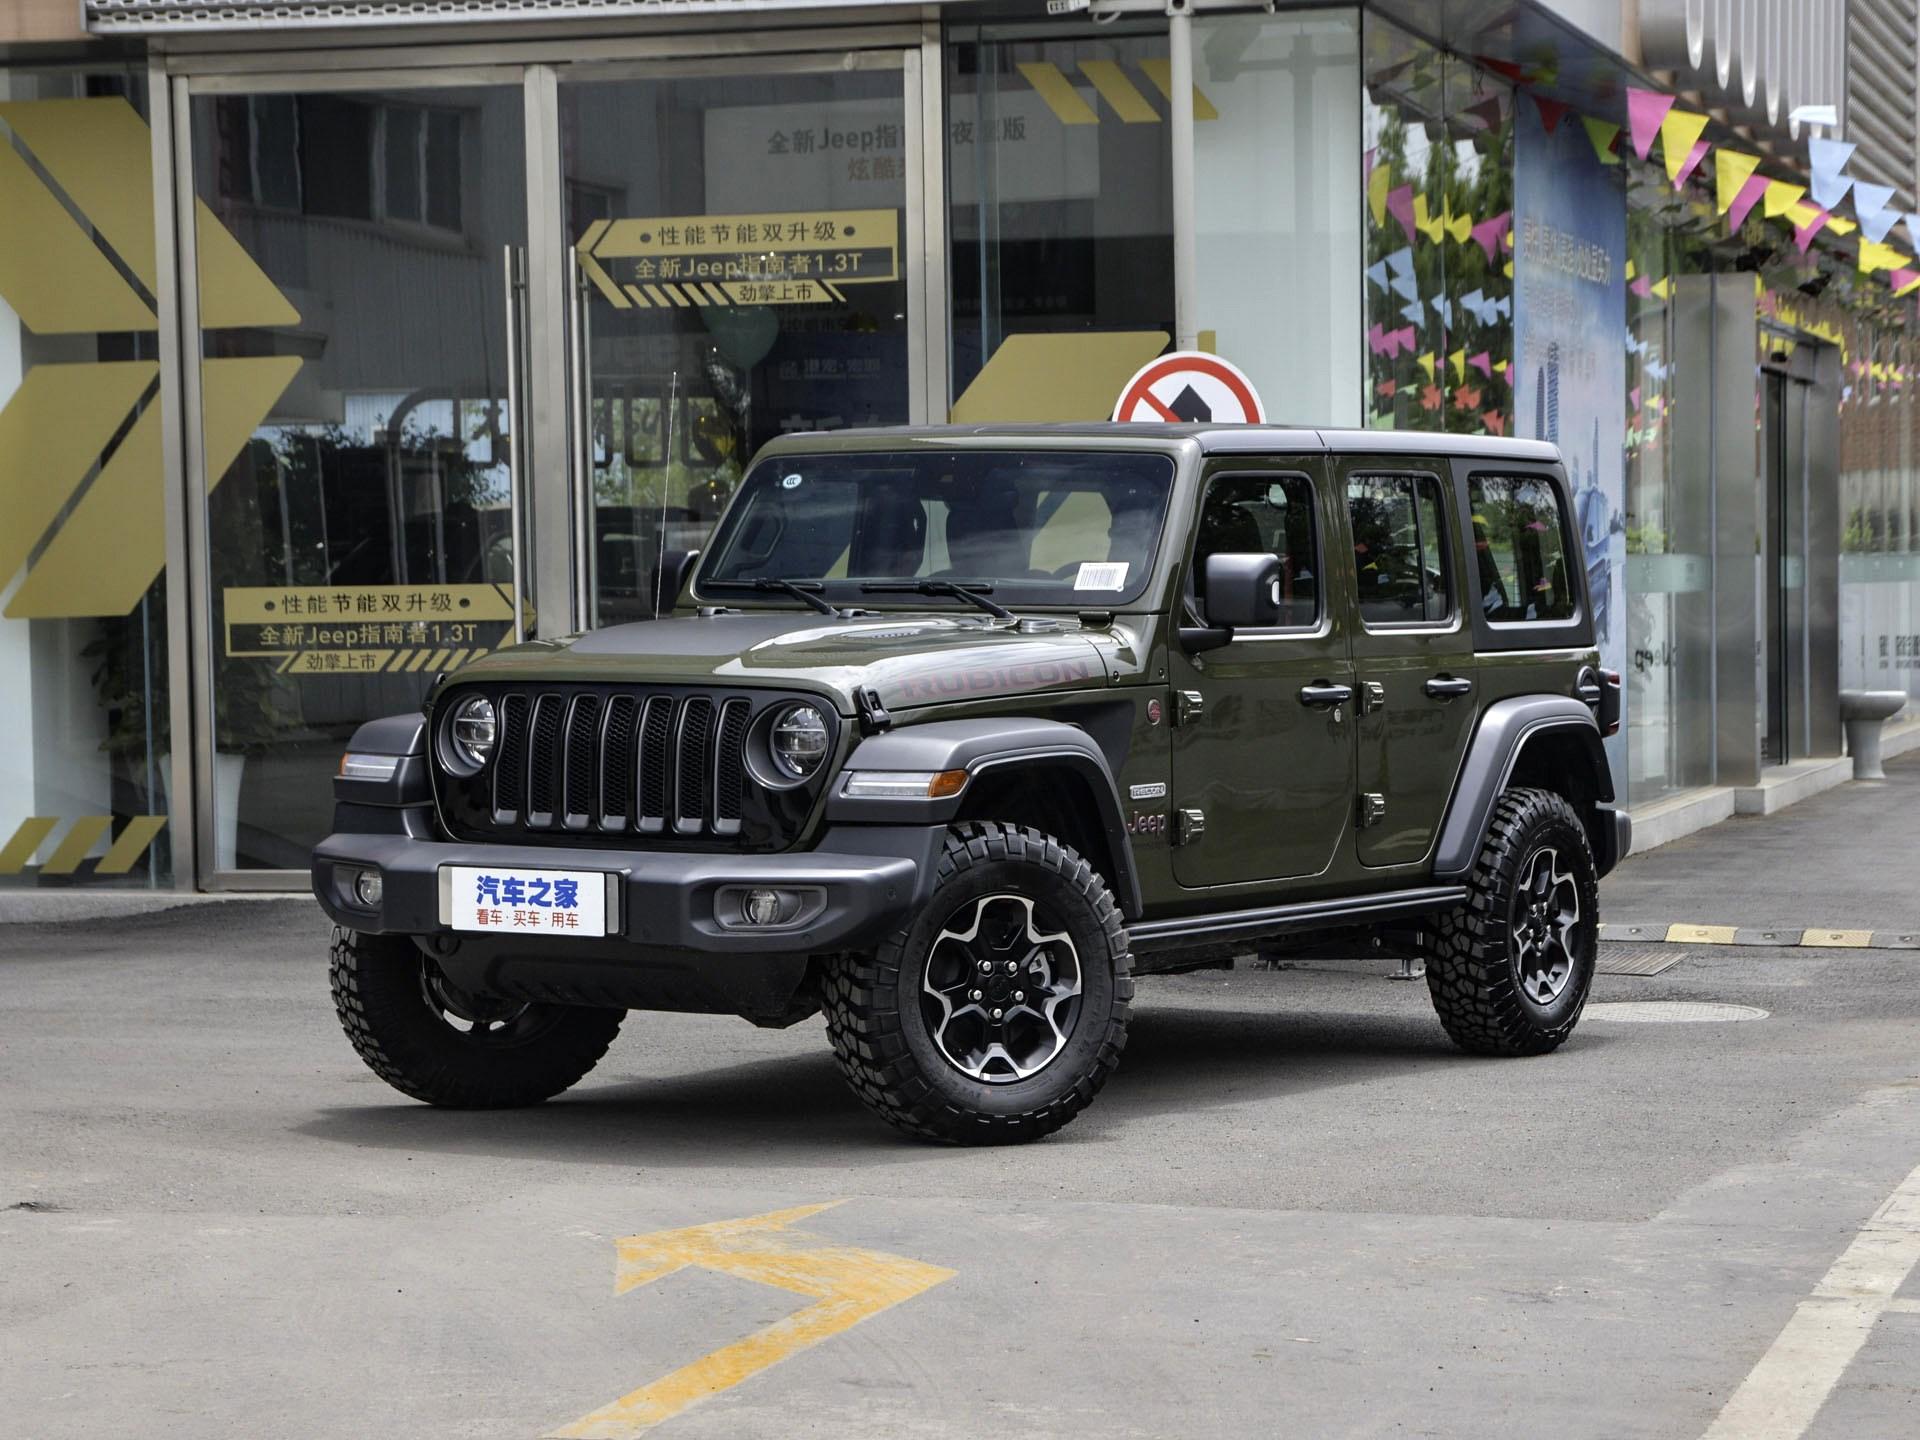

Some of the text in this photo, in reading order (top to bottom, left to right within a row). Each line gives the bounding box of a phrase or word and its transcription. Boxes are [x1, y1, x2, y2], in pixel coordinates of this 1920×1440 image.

[767, 124, 905, 155] 全新Jeep指
[848, 155, 905, 182] 炫酷
[658, 220, 837, 247] 性能节能双升级
[634, 252, 863, 280] 全新Jeep指南者1.3T
[739, 283, 813, 302] 劲擎上市
[281, 592, 453, 615] 性能节能双升级
[259, 623, 478, 648] 全新Jeep指南者1.3T
[305, 653, 377, 671] 劲擎上市
[899, 660, 1090, 698] RUBICON
[1127, 811, 1165, 837] Jeep
[476, 875, 579, 909] 汽车之家
